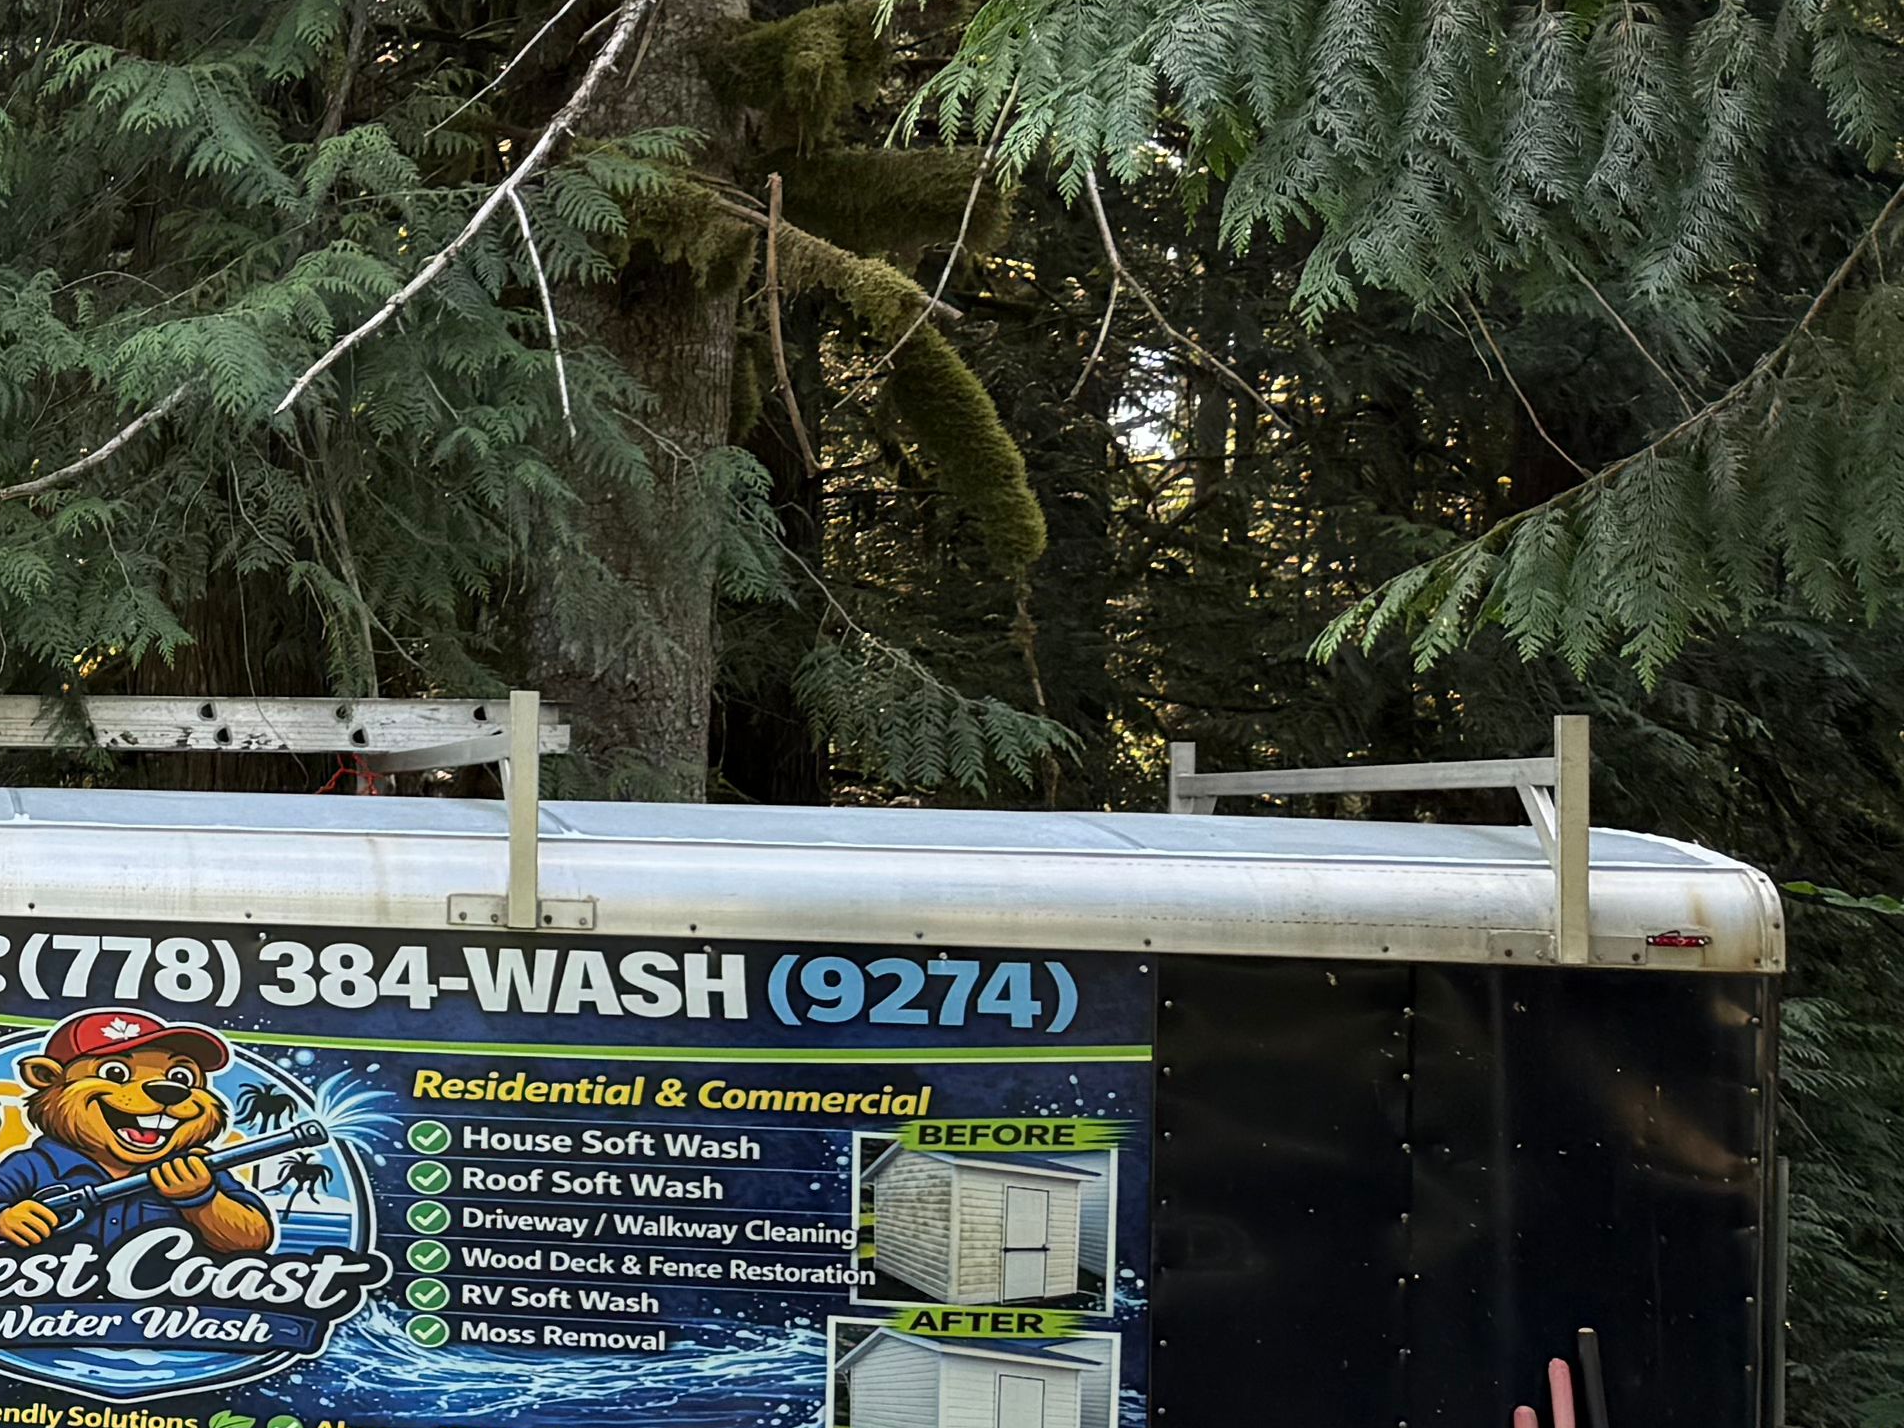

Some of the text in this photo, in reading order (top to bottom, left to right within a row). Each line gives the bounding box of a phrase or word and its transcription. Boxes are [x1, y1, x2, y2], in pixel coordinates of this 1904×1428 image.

[19, 933, 1079, 1033] (778) 384-WASH (9274)
[413, 1069, 930, 1116] Residential & Commercial
[463, 1126, 760, 1160] House Soft Wash
[918, 1124, 1076, 1146] BEFORE
[463, 1167, 723, 1200] Roof Soft Wash
[463, 1207, 857, 1249] Driveway / Walkway Cleaning
[106, 1227, 370, 1310] Coast
[462, 1247, 876, 1287] Wood Deck & Fence Restoration
[462, 1284, 659, 1314] RV Soft Wash
[130, 1307, 271, 1344] Wash
[462, 1322, 666, 1351] Moss Removal
[909, 1311, 1045, 1334] AFTER
